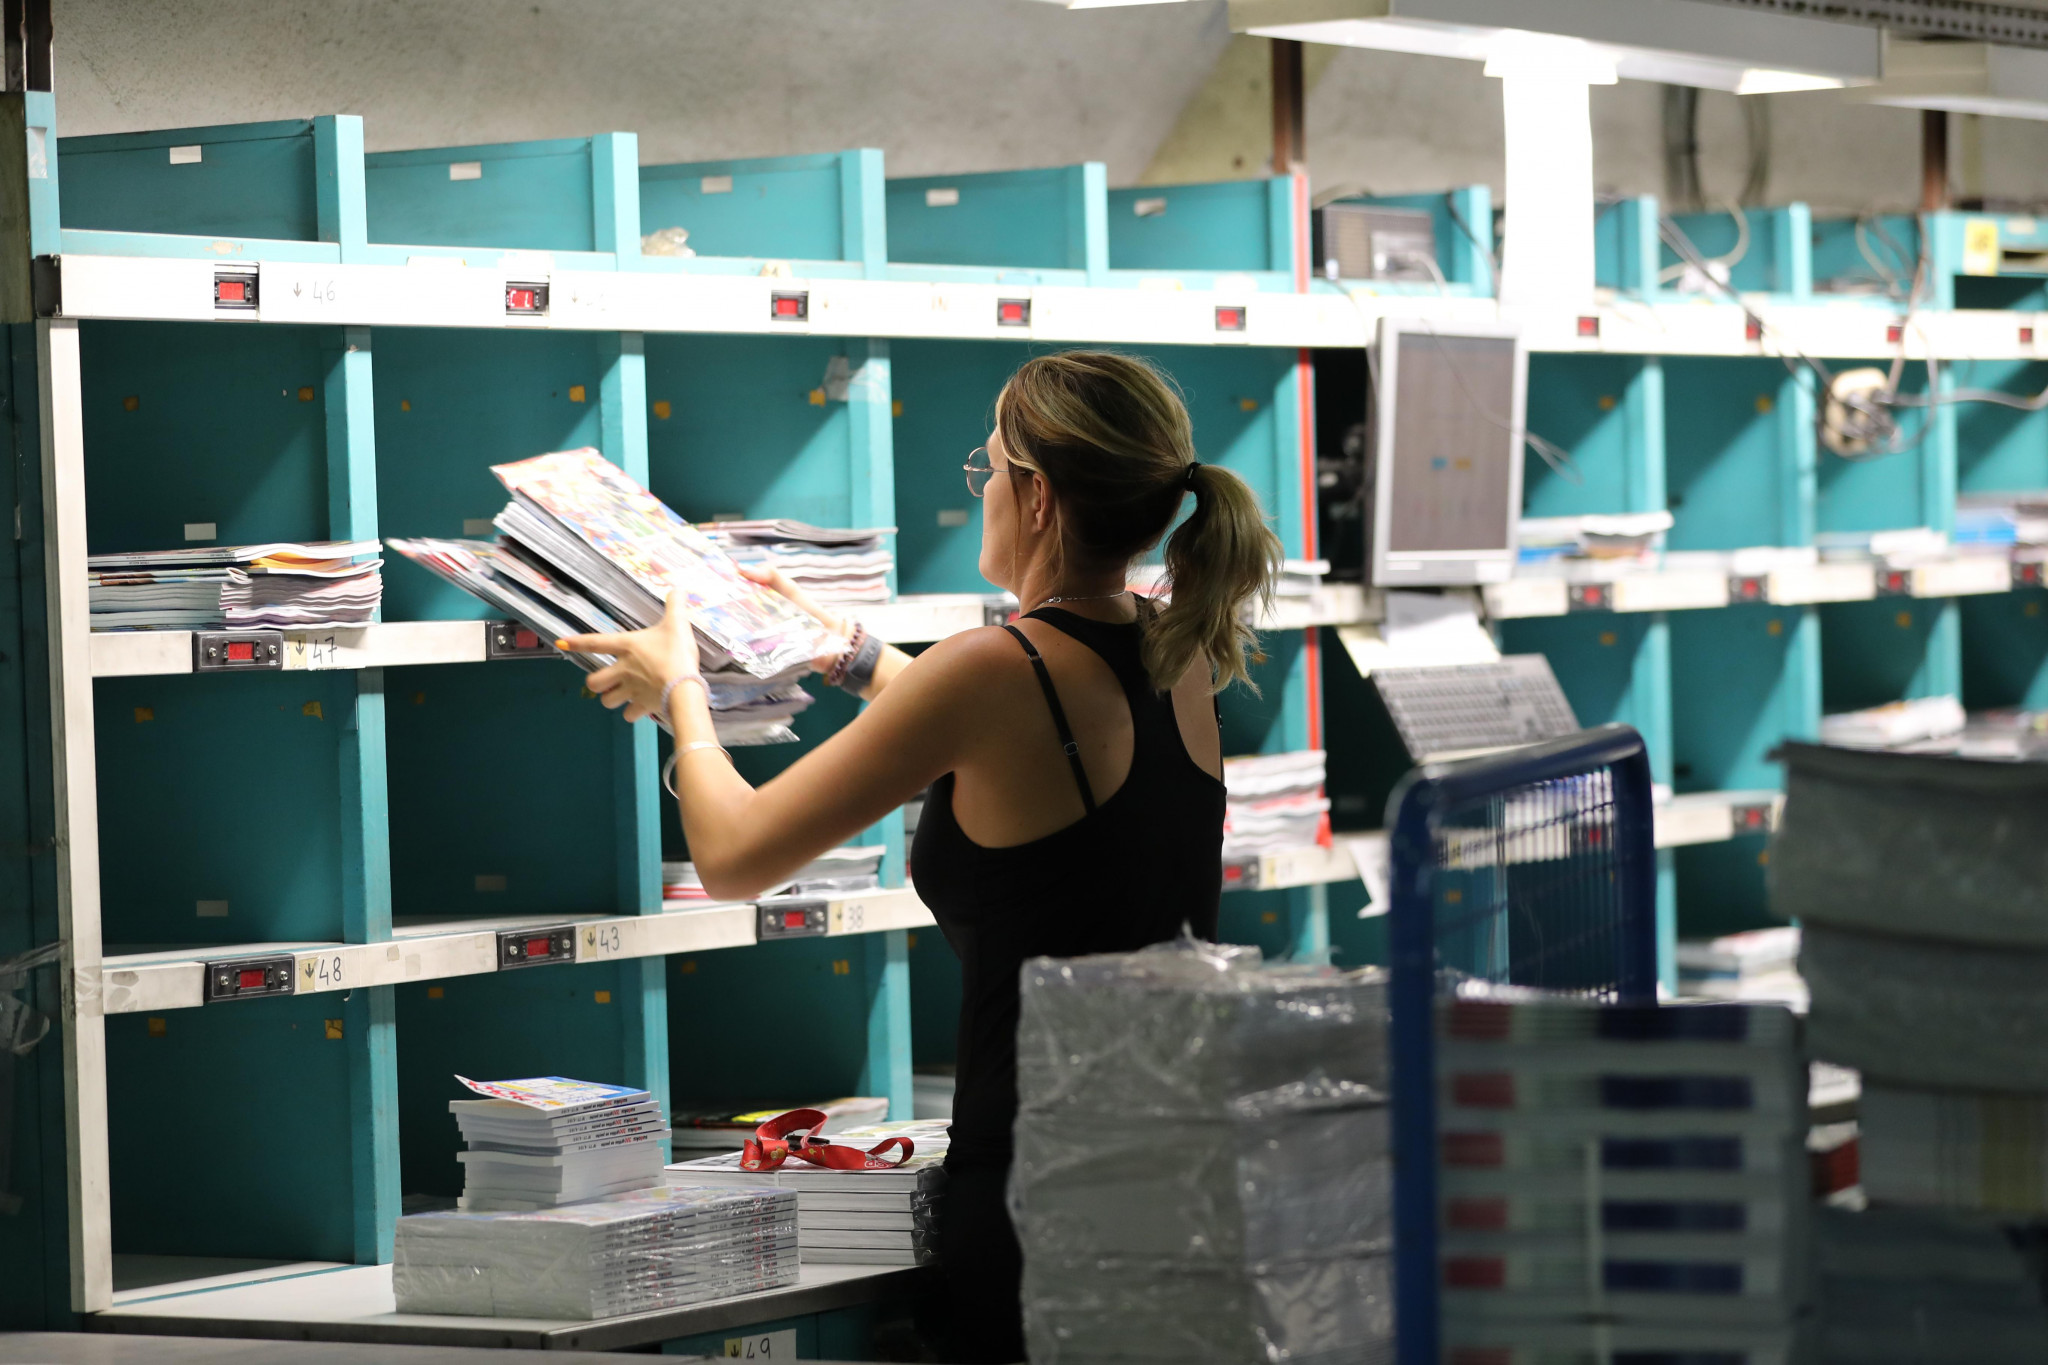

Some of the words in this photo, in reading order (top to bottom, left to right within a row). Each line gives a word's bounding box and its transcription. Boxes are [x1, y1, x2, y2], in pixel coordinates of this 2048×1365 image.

[312, 280, 336, 304] 46
[312, 636, 338, 665] 47
[599, 926, 621, 954] 43
[318, 956, 342, 986] 48
[746, 1337, 771, 1360] 49
